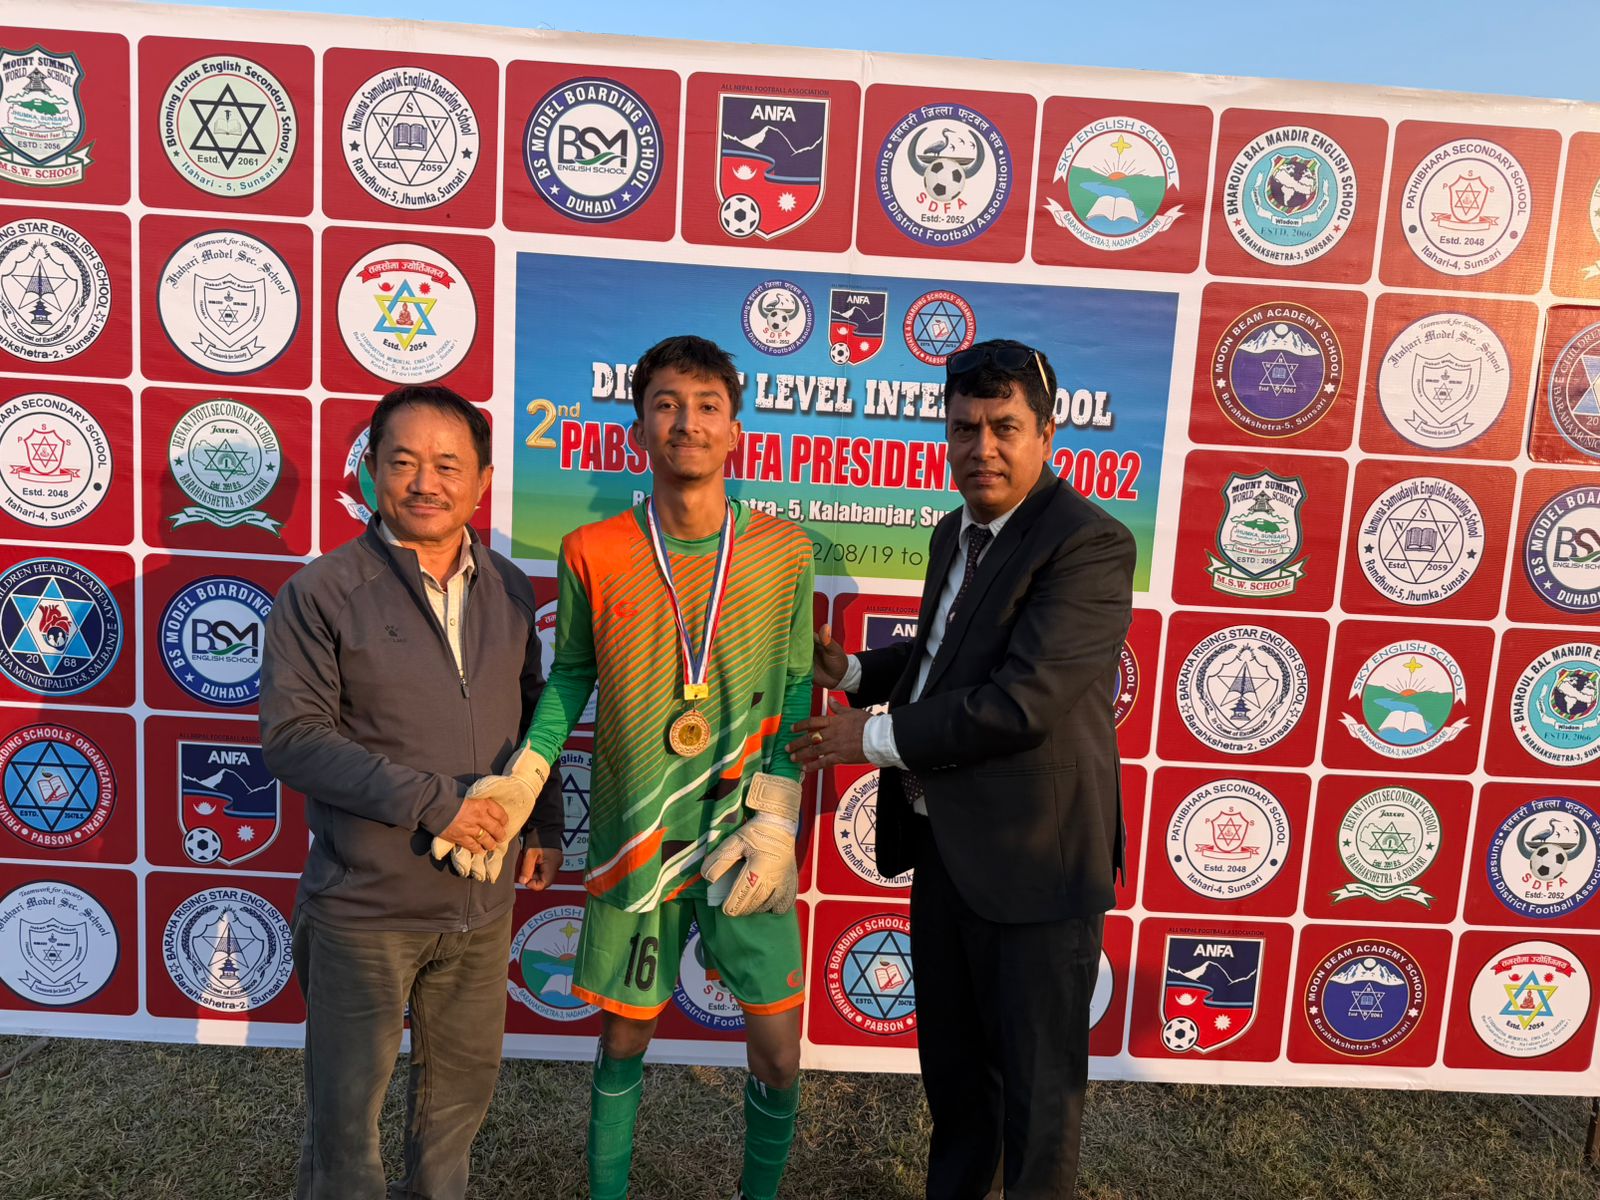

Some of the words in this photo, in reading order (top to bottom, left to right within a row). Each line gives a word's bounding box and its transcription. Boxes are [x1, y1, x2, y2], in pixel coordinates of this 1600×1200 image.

[2, 57, 34, 71] MOUNT
[38, 57, 75, 75] SUMMIT
[4, 67, 27, 83] WORLD
[47, 68, 73, 88] SCHOOL
[347, 100, 370, 132] Namuna
[361, 71, 403, 104] Samudayik
[403, 71, 432, 91] English
[430, 78, 462, 114] Boarding
[455, 108, 476, 136] School
[564, 86, 643, 123] BOARDING
[754, 86, 787, 94] FOOTBALL
[788, 88, 830, 96] ASSOCIATION
[165, 93, 181, 148] Blooming
[174, 69, 200, 93] Lotus
[201, 60, 241, 74] English
[244, 65, 287, 112] Secondary
[280, 115, 292, 153] School
[750, 104, 796, 122] ANFA
[531, 100, 564, 152] MODEL
[17, 141, 38, 149] ESTD
[557, 124, 629, 168] BSM
[630, 125, 655, 189] SCHOOL
[1058, 142, 1075, 173] SKY
[1076, 119, 1135, 144] ENGLISH
[1138, 125, 1177, 180] SCHOOL
[0, 161, 32, 177] M.S.W.
[35, 166, 79, 178] SCHOOL
[197, 154, 220, 164] Estd.
[237, 157, 259, 166] 2061
[377, 161, 399, 169] Estd.
[420, 163, 443, 172] 2059
[533, 158, 551, 180] BS
[557, 164, 592, 172] ENGLISH
[592, 166, 627, 175] SCHOOL
[181, 161, 214, 187] Itahari
[240, 164, 278, 190] Sunsari
[351, 157, 400, 204] Ramdhuni-5,
[400, 191, 440, 205] Jhumka,
[437, 168, 468, 198] Sunsari
[1226, 161, 1248, 216] BHAROUL
[1243, 142, 1265, 161] BAL
[1265, 129, 1310, 147] MANDIR
[1310, 134, 1349, 174] ENGLISH
[1336, 175, 1354, 221] SCHOOL
[1406, 150, 1452, 209] PATHIBHARA
[1451, 143, 1515, 171] SECONDARY
[1510, 170, 1527, 216] SCHOOL
[566, 195, 617, 214] DUHADI
[880, 150, 894, 200] Sunsari
[887, 201, 923, 237] District
[926, 223, 976, 241] Football
[977, 156, 1008, 228] Association
[945, 215, 965, 224] 2052
[1439, 236, 1461, 245] Estd.
[1464, 237, 1485, 246] 2048
[17, 222, 49, 234] STAR
[51, 225, 98, 261] ENGLISH
[92, 261, 109, 310] SCHOOL
[201, 249, 233, 264] Model
[235, 250, 257, 266] Sec.
[1421, 245, 1461, 271] Itahari-4,
[1464, 248, 1502, 270] Sunsari
[846, 295, 871, 305] ANFA
[65, 323, 100, 354] Sunsari
[382, 339, 401, 351] Estd.
[409, 341, 428, 351] 2054
[1215, 336, 1234, 373] MOON
[1232, 311, 1263, 336] BEAM
[1266, 308, 1322, 331] ACADEMY
[1320, 331, 1339, 379] SCHOOL
[754, 372, 852, 414] LEVEL
[1051, 387, 1112, 426] OOL
[1221, 392, 1294, 431] Barahakshetra-5,
[21, 398, 88, 425] SECONDARY
[85, 423, 107, 469] SCHOOL
[172, 419, 194, 449] JEEVAN
[188, 406, 212, 425] JYOTI
[211, 403, 260, 426] SECONDARY
[254, 422, 278, 454] SCHOOL
[525, 398, 582, 449] 2nd
[348, 441, 363, 467] SKY
[560, 420, 654, 475] PABS
[1052, 447, 1142, 501] 2082
[22, 487, 45, 497] Estd.
[47, 489, 69, 498] 2048
[179, 472, 234, 508] BARAHAKSHETRA
[1231, 481, 1262, 494] MOUNT
[1265, 481, 1299, 497] SUMMIT
[50, 499, 88, 521] Sunsari
[809, 500, 915, 528] Kalabanjar,
[1464, 513, 1482, 539] School
[1531, 504, 1565, 551] MODEL
[902, 547, 923, 566] to
[33, 563, 72, 575] HEART
[72, 571, 115, 621] ACADEMY
[1249, 579, 1291, 591] SCHOOL
[1405, 589, 1443, 601] Jhumka,
[195, 583, 272, 617] BOARDING
[166, 596, 196, 644] MODEL
[87, 633, 117, 675] SALBANI
[169, 649, 186, 669] BS
[225, 656, 258, 664] SCHOOL
[1178, 658, 1195, 701] BARAHA
[1192, 632, 1227, 659] RISING
[1229, 628, 1258, 639] STAR
[1260, 631, 1300, 663] ENGLISH
[1294, 663, 1307, 706] SCHOOL
[1531, 657, 1551, 674] BAL
[1551, 645, 1593, 661] MANDIR
[1353, 664, 1370, 690] SKY
[1372, 643, 1427, 663] ENGLISH
[1429, 647, 1464, 695] SCHOOL
[200, 682, 250, 699] DUHADI
[22, 728, 75, 742] SCHOOLS'
[207, 750, 251, 766] ANFA
[1212, 783, 1273, 807] SECONDARY
[1269, 806, 1286, 846] SCHOOL
[31, 833, 73, 845] PABSON
[1204, 864, 1225, 872] Estd.
[176, 893, 208, 919] RISING
[208, 890, 238, 900] STAR
[240, 893, 283, 924] ENGLISH
[1495, 881, 1527, 911] District
[1528, 899, 1573, 915] Football
[527, 908, 582, 930] ENGLISH
[830, 926, 864, 969] BOARDING
[1193, 944, 1235, 958] ANFA
[624, 932, 659, 992] 16
[1308, 970, 1326, 1002] MOON
[1324, 948, 1353, 970] BEAM
[1356, 944, 1407, 964] ACADEMY
[1405, 963, 1422, 1005] SCHOOL
[864, 1019, 904, 1031] PABSON
